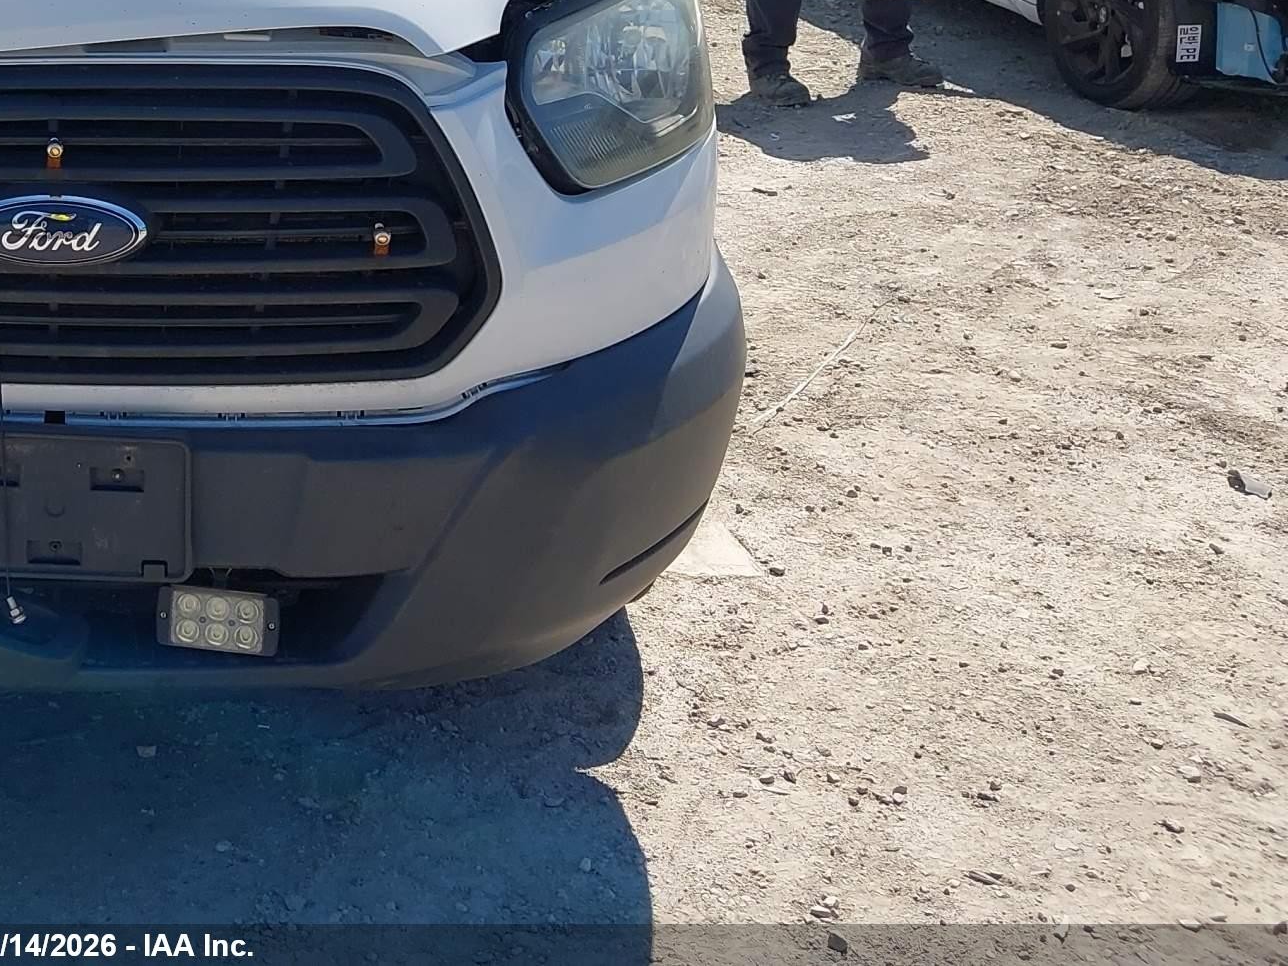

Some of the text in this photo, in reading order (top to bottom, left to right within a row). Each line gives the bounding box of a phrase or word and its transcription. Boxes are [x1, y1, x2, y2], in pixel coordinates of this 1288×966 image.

[1180, 27, 1199, 60] 일반 PE
[1, 211, 102, 251] Ford
